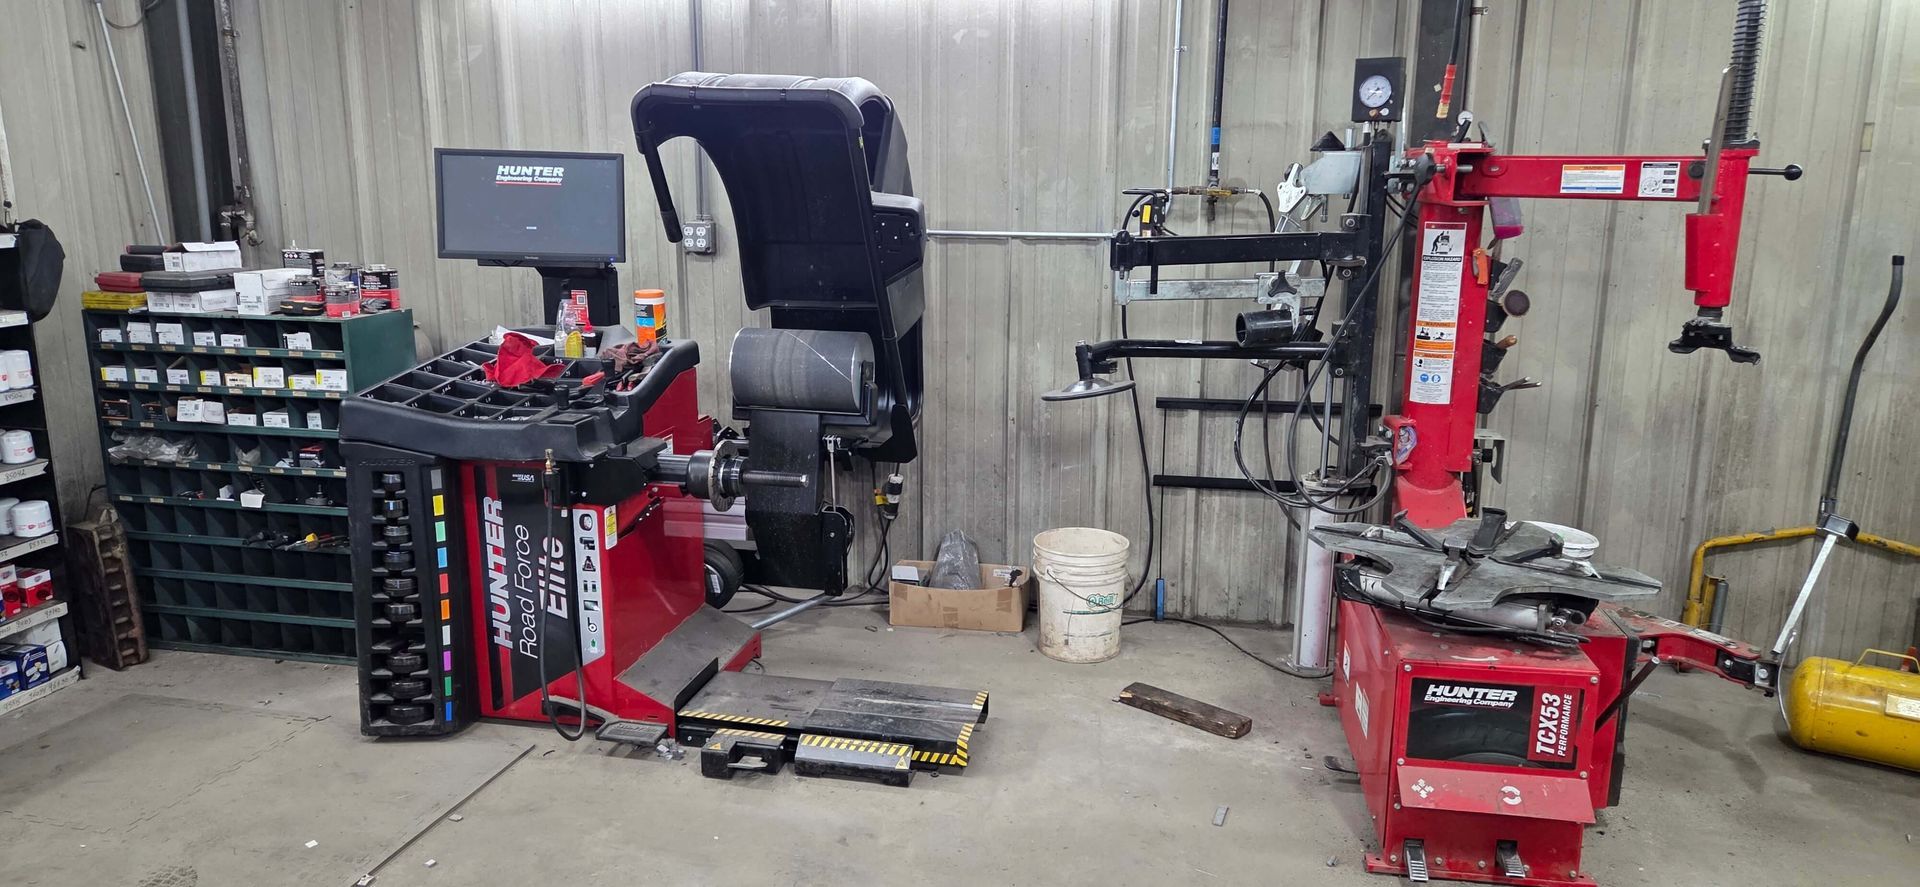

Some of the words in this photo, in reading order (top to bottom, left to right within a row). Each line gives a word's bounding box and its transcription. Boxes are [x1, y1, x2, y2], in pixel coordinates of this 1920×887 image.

[497, 165, 564, 176] HUNTER
[483, 496, 513, 650] HUNTER
[513, 524, 534, 593] Force
[538, 536, 569, 620] Elite
[515, 595, 538, 659] Road
[1424, 695, 1472, 705] Engineering
[1474, 698, 1514, 708] Company
[1426, 684, 1518, 702] HUNTER
[1535, 692, 1561, 756] TCX53
[1557, 693, 1573, 757] PERFORMANCE
